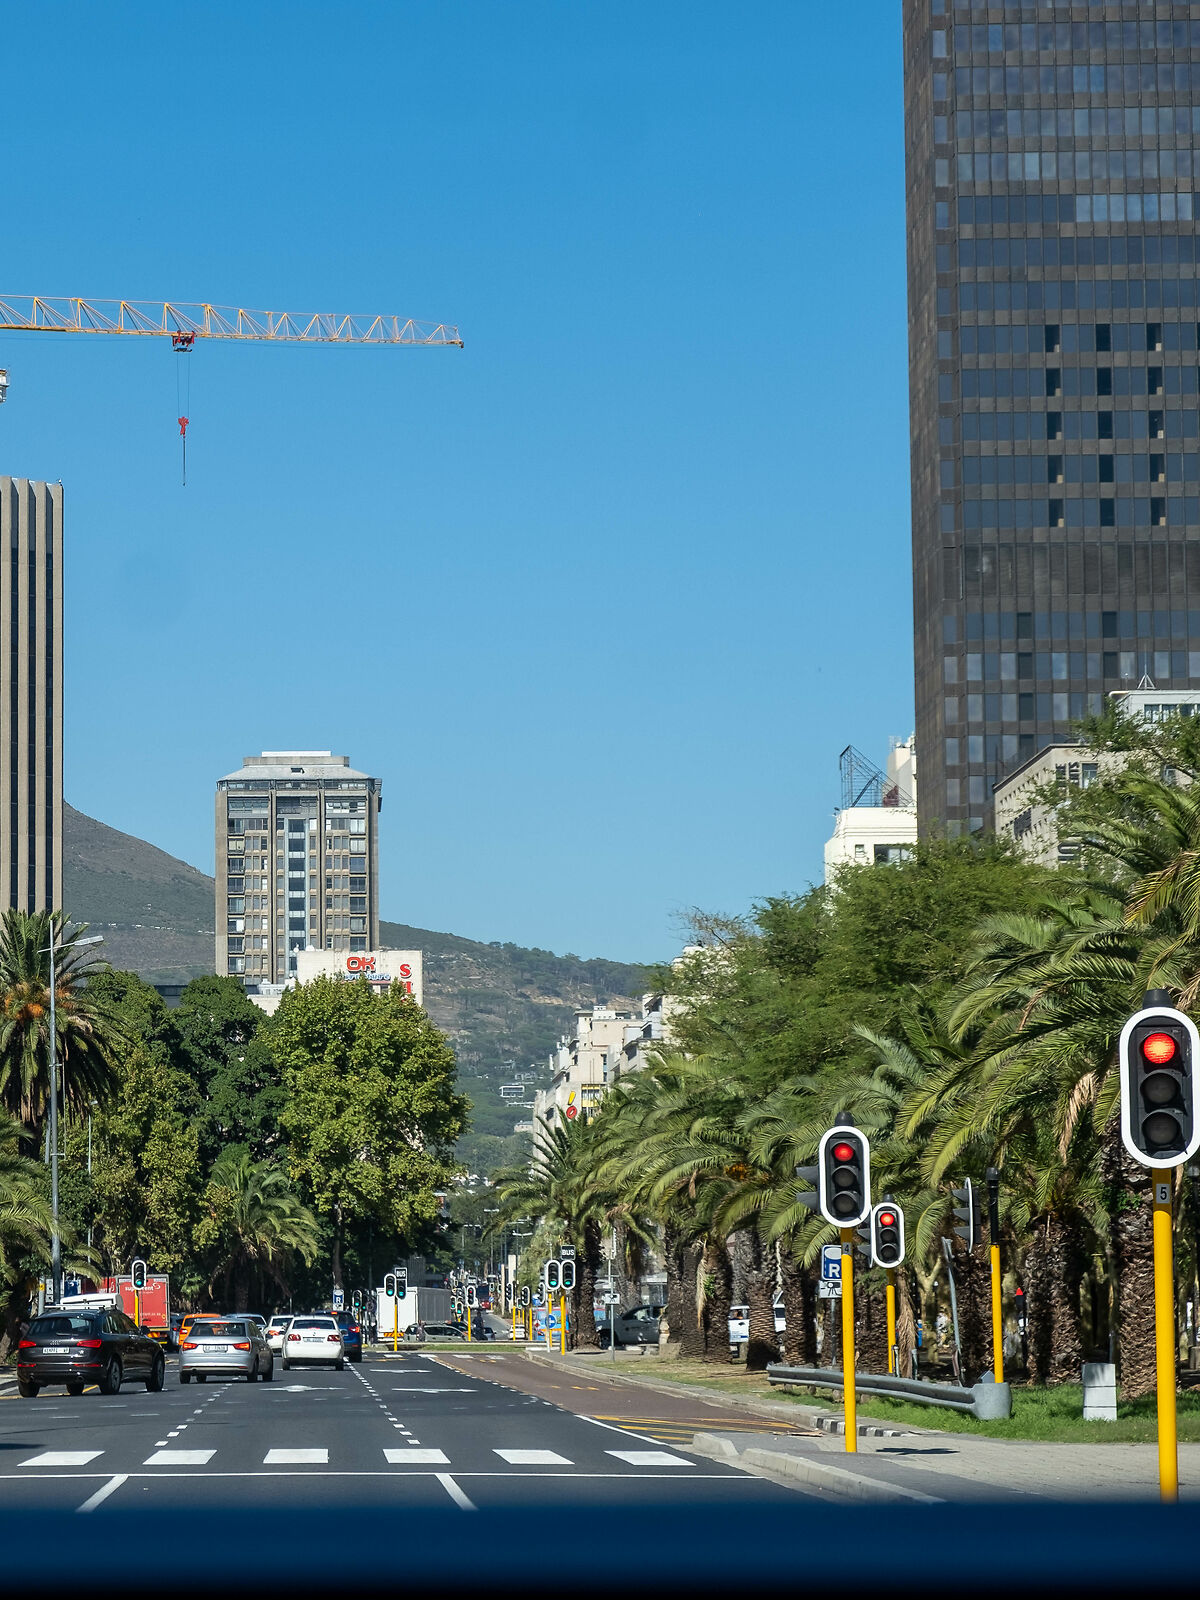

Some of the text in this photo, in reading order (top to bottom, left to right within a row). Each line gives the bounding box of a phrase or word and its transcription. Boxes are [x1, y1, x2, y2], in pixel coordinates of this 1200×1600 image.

[346, 956, 375, 972] OK
[1160, 1186, 1167, 1200] 5
[828, 1263, 841, 1278] R
